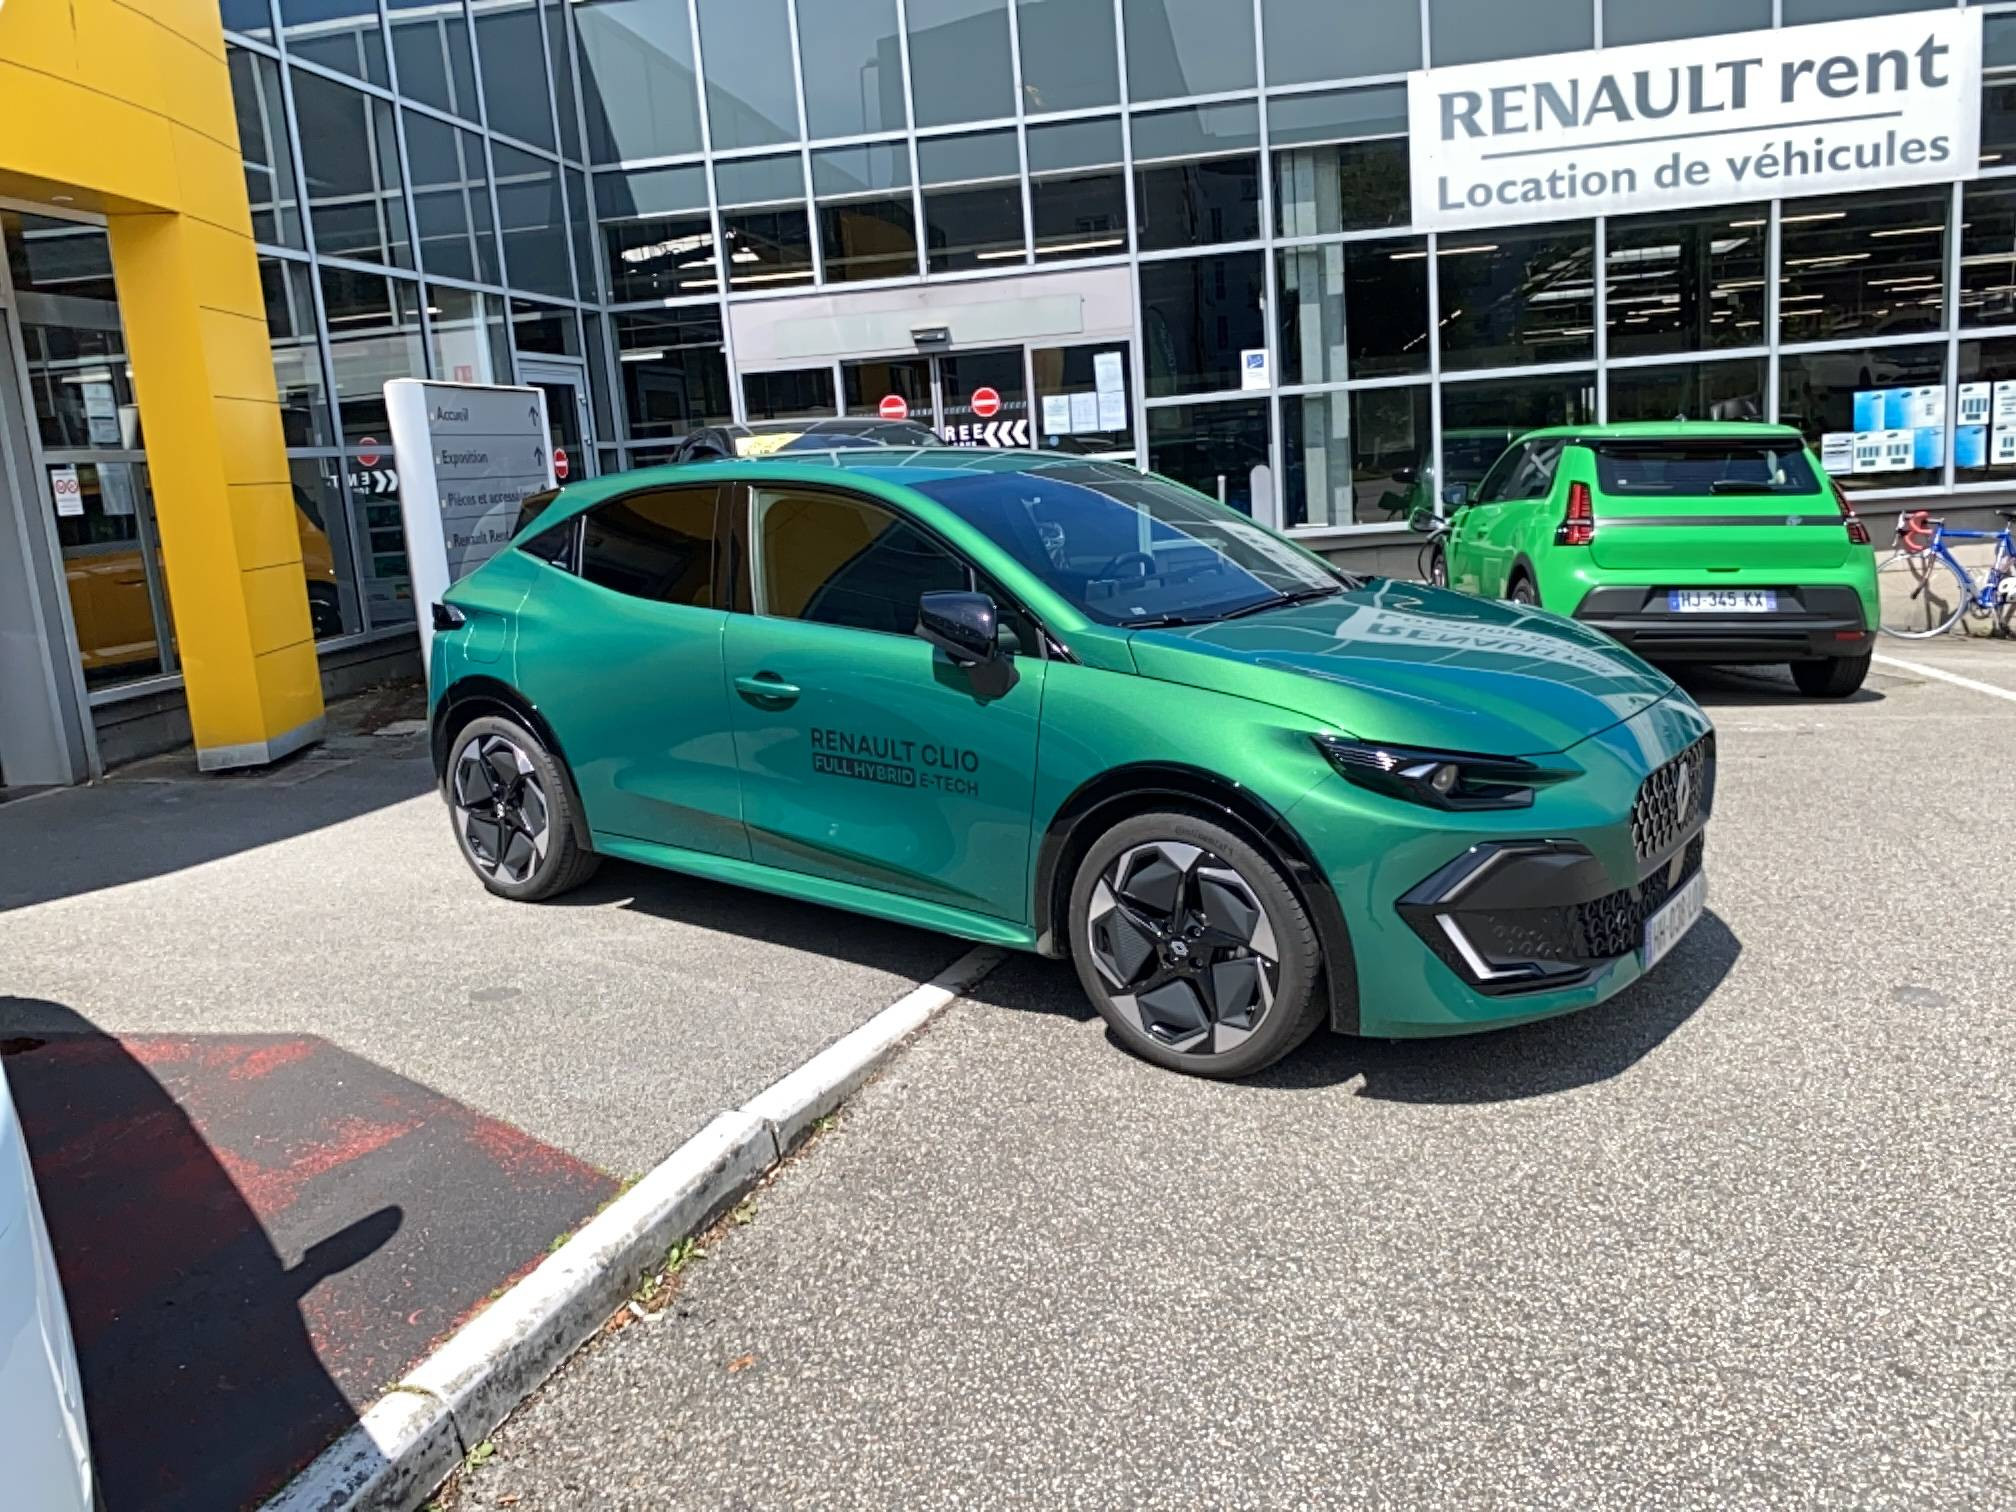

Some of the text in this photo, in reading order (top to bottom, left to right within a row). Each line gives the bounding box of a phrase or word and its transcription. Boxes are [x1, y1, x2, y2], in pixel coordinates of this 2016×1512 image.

[1437, 33, 1950, 141] RENAULT rent
[1438, 130, 1950, 211] Location de véhicules
[437, 406, 469, 422] Accueil
[442, 450, 488, 468] Exposition
[478, 494, 489, 505] et
[811, 727, 979, 773] RENAULT CLIO
[920, 773, 979, 797] E-TECH
